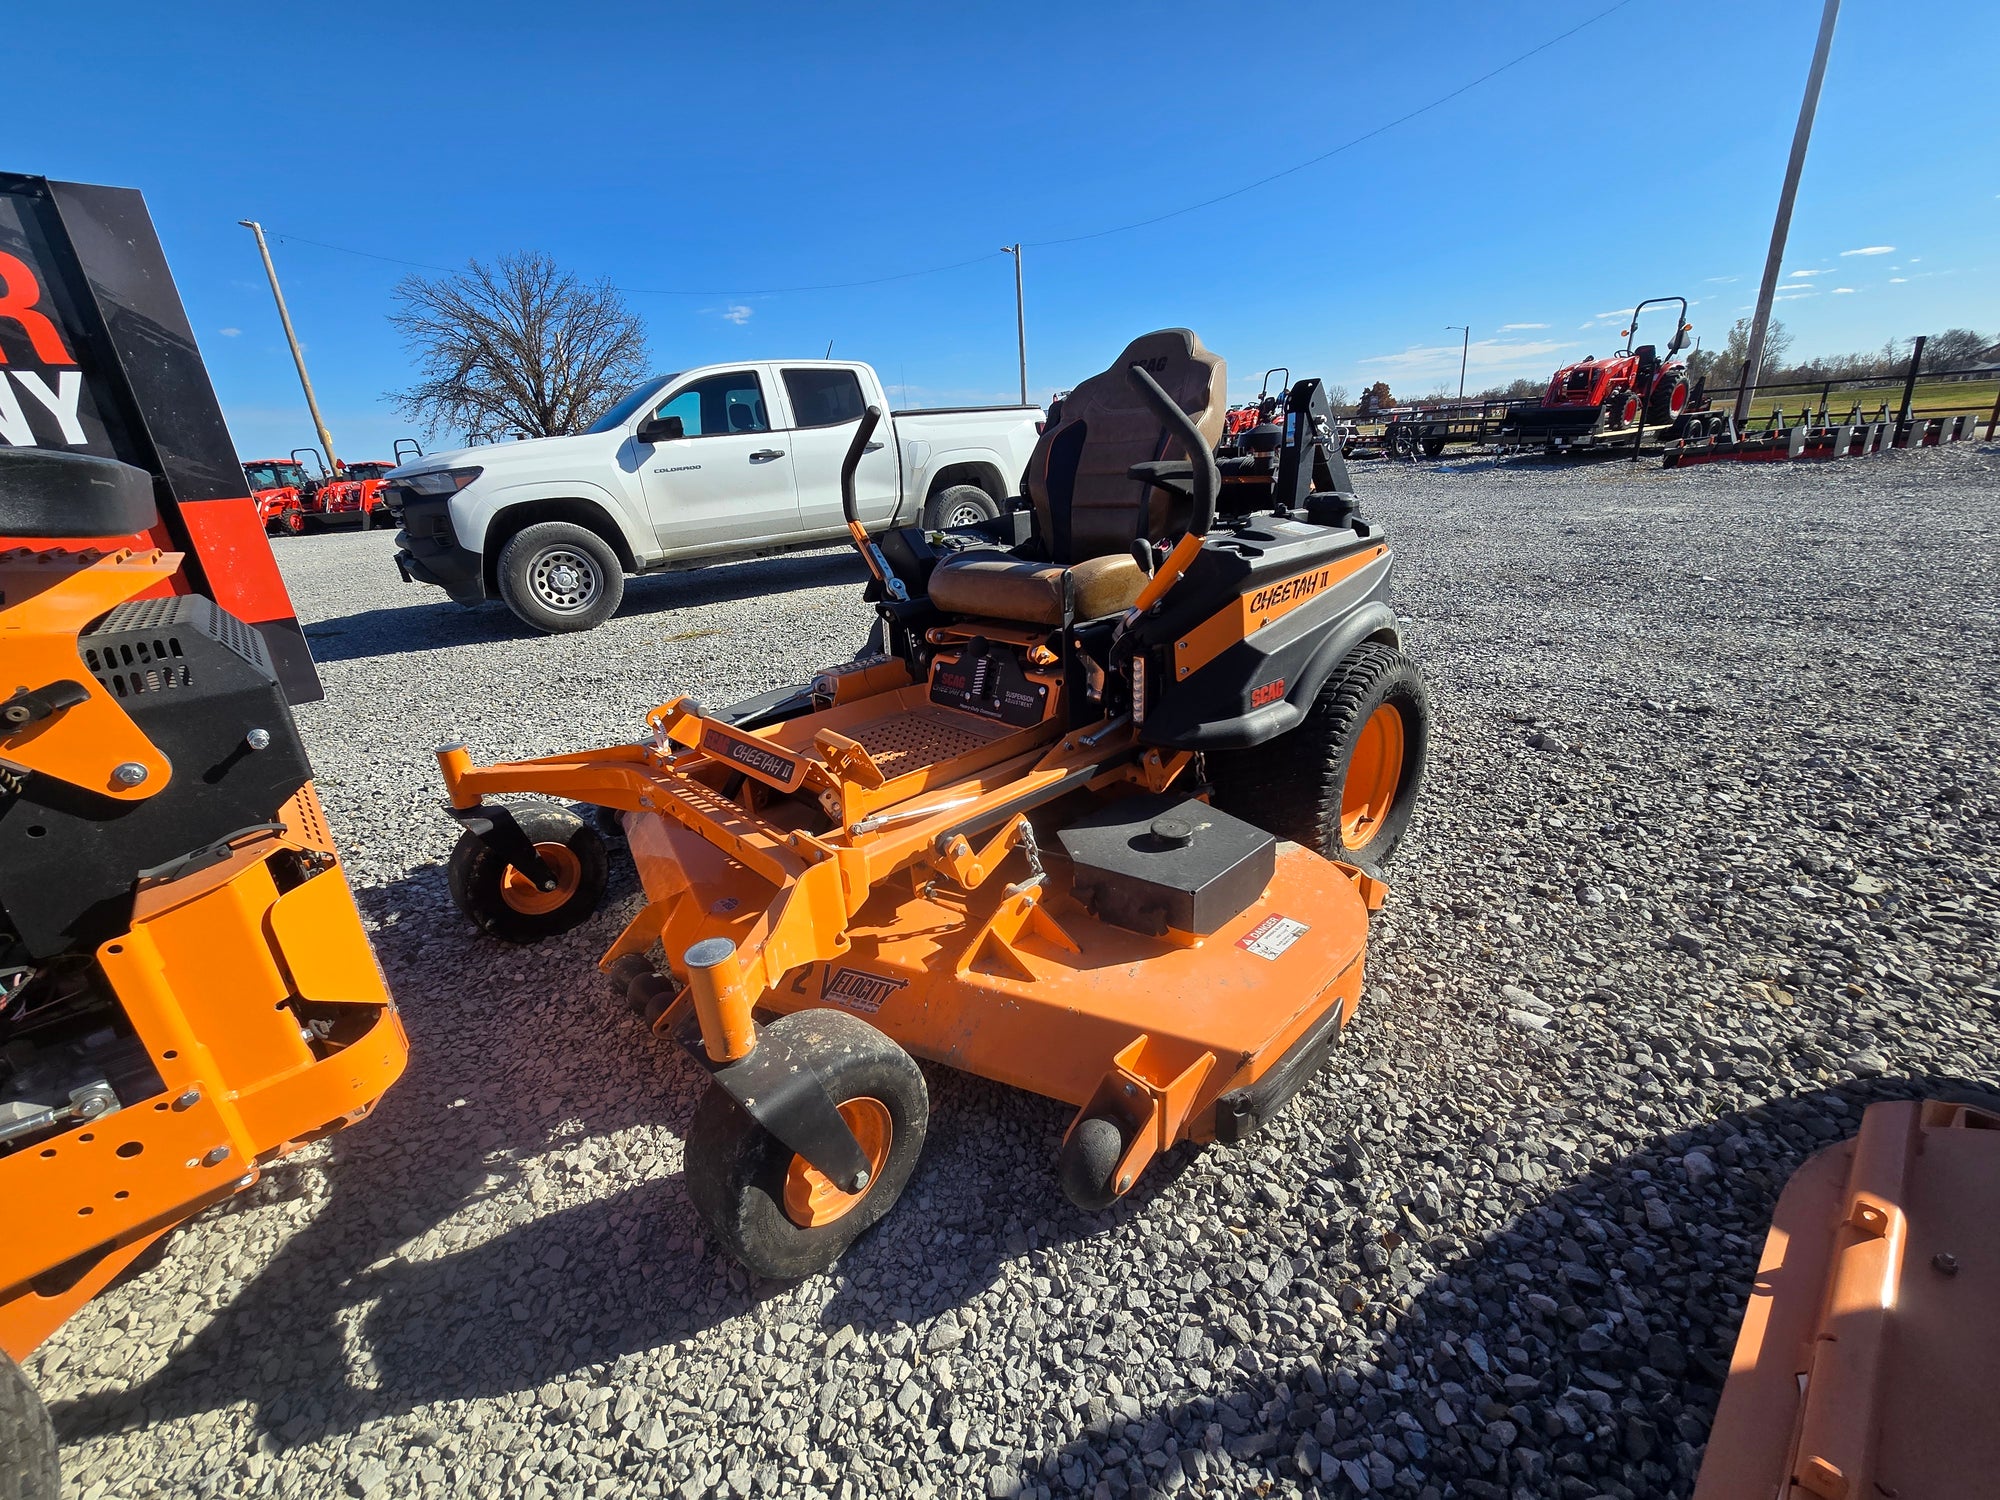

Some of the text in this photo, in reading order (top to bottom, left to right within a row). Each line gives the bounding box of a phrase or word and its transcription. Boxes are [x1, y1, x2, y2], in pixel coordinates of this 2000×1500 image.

[653, 464, 702, 474] COLORADO
[1250, 570, 1329, 613] CHEETAH II
[942, 673, 966, 688] SCAG
[1004, 698, 1033, 709] ADJUSTMENT
[1005, 691, 1034, 702] SUSPENSION
[1251, 678, 1286, 708] SCAG
[704, 730, 793, 779] SCAG CHEETAH II
[1250, 916, 1280, 939] DANGER
[781, 961, 815, 996] 2
